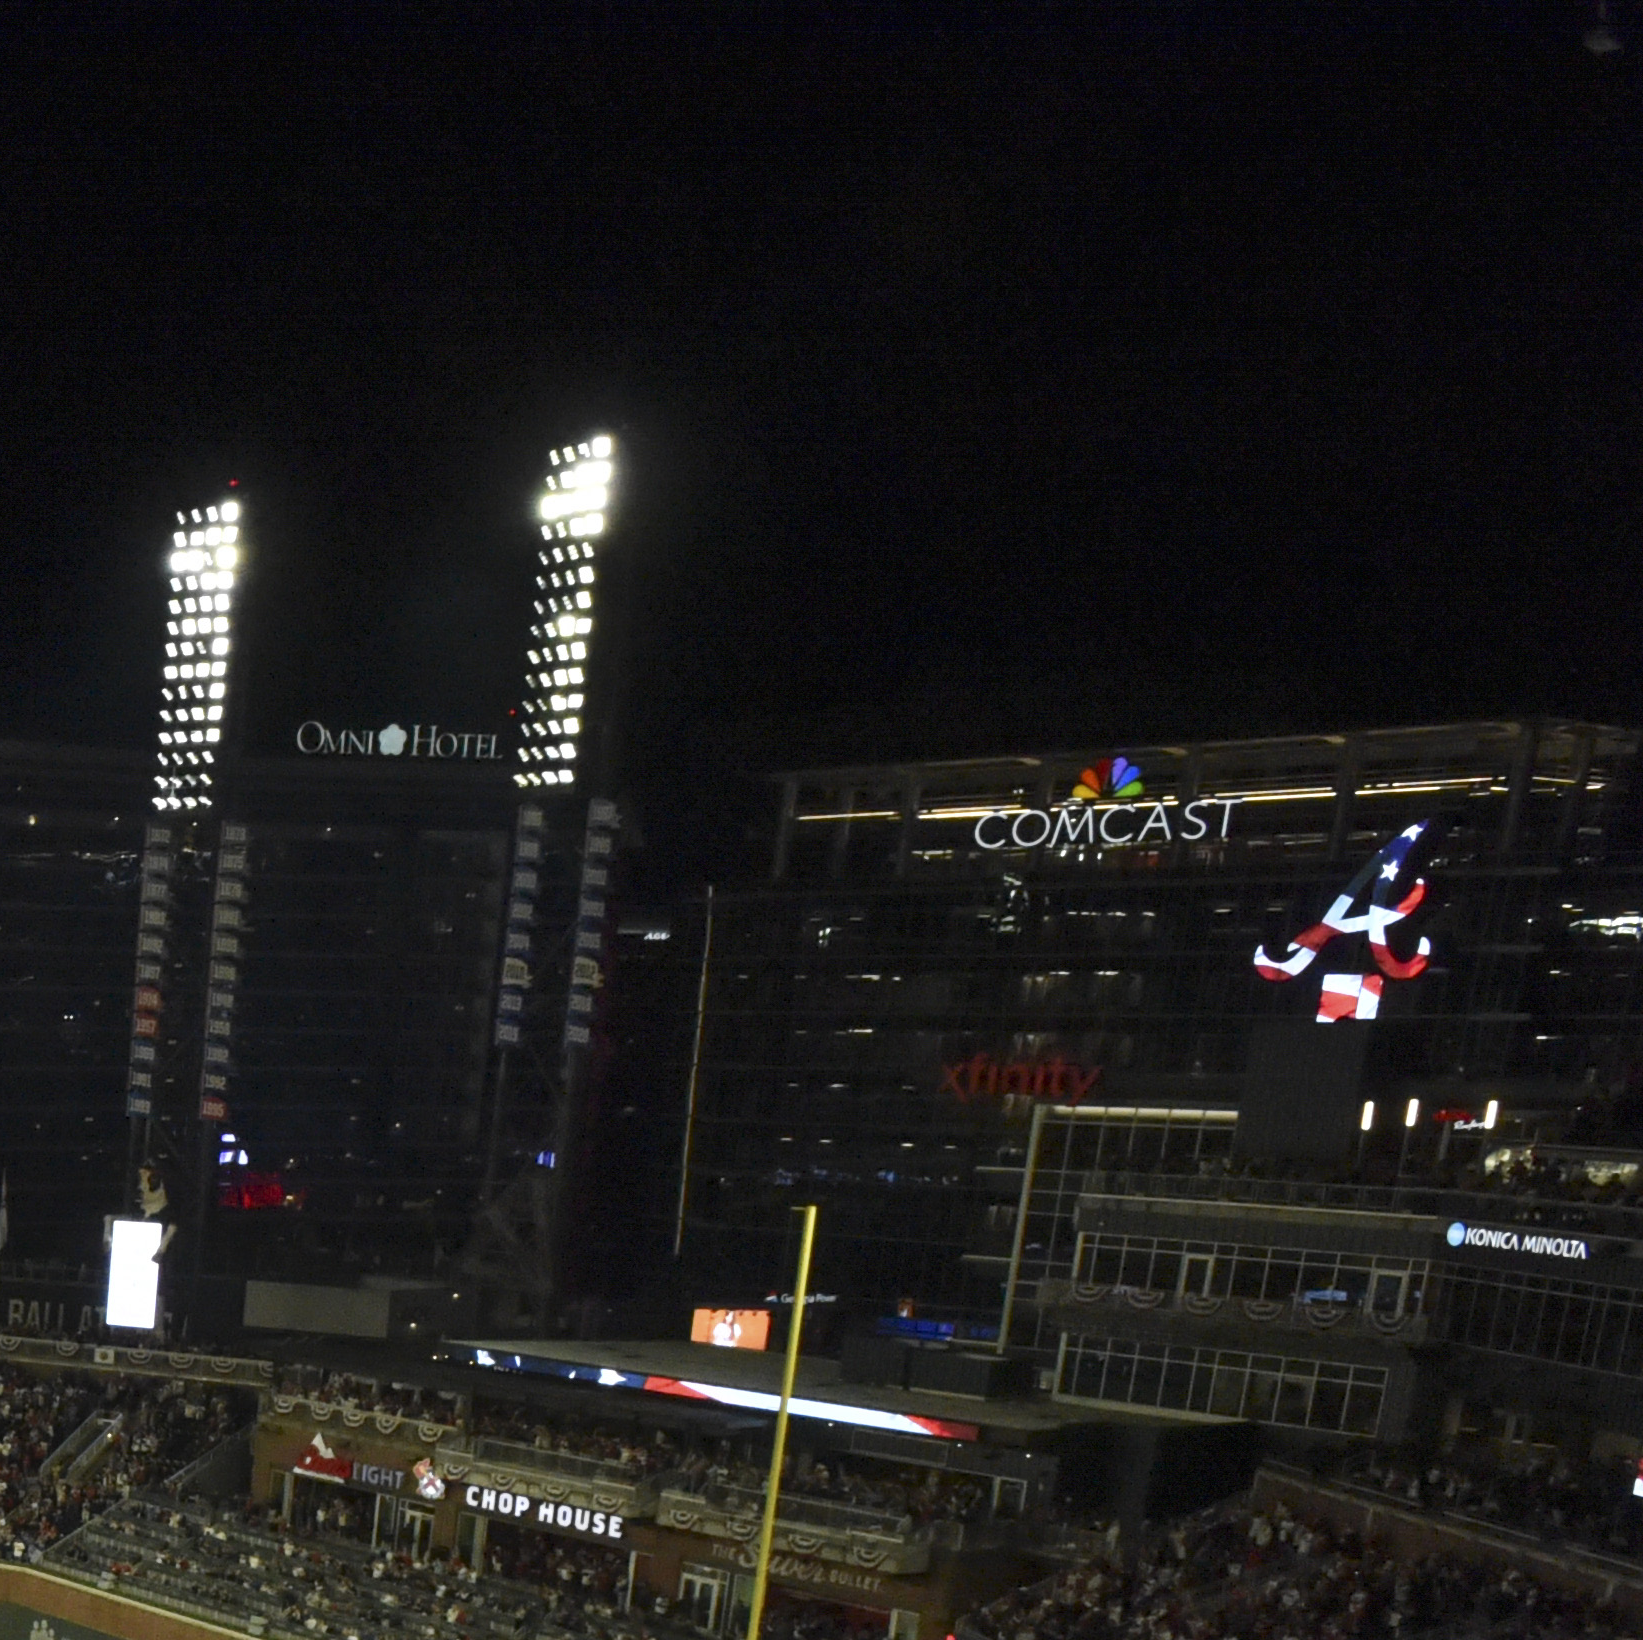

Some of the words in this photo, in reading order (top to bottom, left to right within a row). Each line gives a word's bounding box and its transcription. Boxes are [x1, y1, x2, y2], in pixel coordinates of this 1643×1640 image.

[296, 721, 374, 755] OMNI
[410, 724, 504, 759] HOTEL
[974, 799, 1243, 850] COMCAST
[1465, 1228, 1519, 1250] KONICA
[1522, 1234, 1588, 1260] MINOLTA
[352, 1461, 405, 1490] LIGHT
[465, 1484, 530, 1518] CHOP
[538, 1500, 624, 1540] HOUSE
